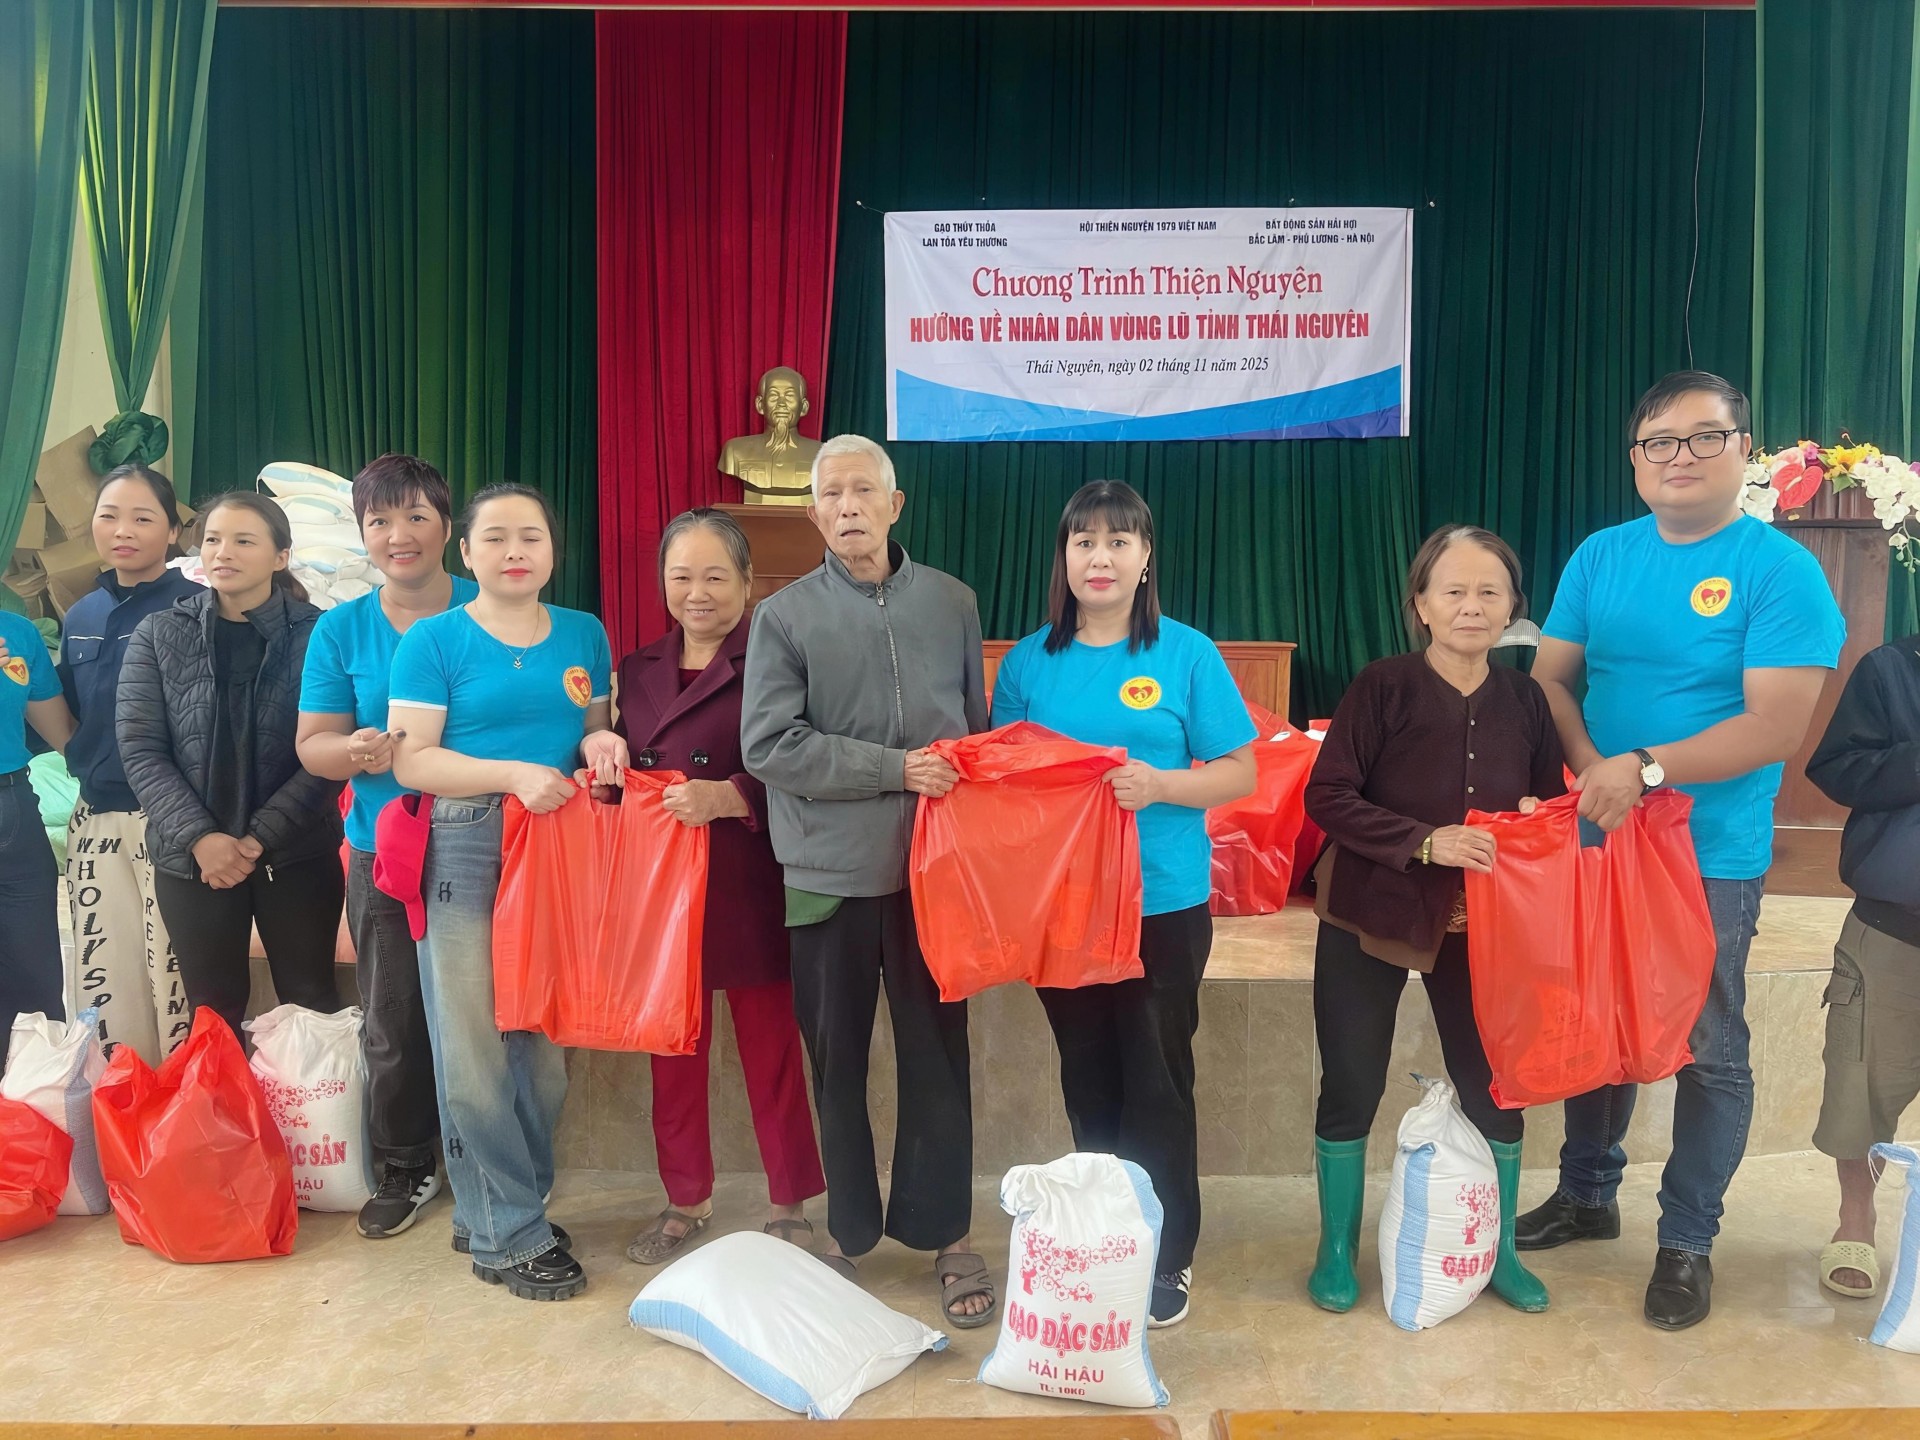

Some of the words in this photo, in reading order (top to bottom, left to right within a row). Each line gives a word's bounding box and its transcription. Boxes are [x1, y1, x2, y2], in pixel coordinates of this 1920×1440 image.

[934, 223, 951, 234] GẠO
[1080, 221, 1094, 233] HỘI
[1096, 221, 1119, 232] THIỆN
[1122, 220, 1154, 232] NGUYỆN
[1157, 222, 1176, 231] 1979
[1179, 220, 1195, 232] VIỆT
[1198, 221, 1217, 231] NAM
[1265, 218, 1281, 230] BẤT
[1283, 219, 1306, 231] ĐỘNG
[1308, 217, 1325, 229] SẢN
[922, 238, 939, 247] LAN
[958, 236, 973, 247] YÊU
[975, 237, 1008, 247] THƯƠNG
[1311, 234, 1339, 244] LƯƠNG
[1347, 233, 1358, 243] HÀ
[1360, 232, 1375, 244] NỘI
[972, 267, 1073, 303] Chương
[1078, 267, 1146, 296] Trình
[1150, 265, 1222, 301] Thiện
[1226, 265, 1323, 300] Nguyện
[910, 312, 974, 342] HƯỚNG
[979, 309, 1002, 342] VỀ
[1008, 312, 1059, 342] NHÂN
[1066, 312, 1103, 342] DÂN
[1110, 312, 1161, 341] VÙNG
[1168, 311, 1190, 340] LŨ
[1196, 309, 1239, 340] TỈNH
[1246, 310, 1289, 339] THÁI
[1295, 309, 1369, 339] NGUYÊN
[1026, 360, 1054, 374] Thái
[1056, 359, 1104, 376] Nguyên,
[1108, 359, 1136, 375] ngày
[1139, 359, 1153, 372] 02
[1157, 358, 1191, 375] tháng
[1193, 358, 1207, 372] 11
[1211, 359, 1237, 372] năm
[1241, 357, 1269, 371] 2025
[309, 1134, 347, 1167] SẢN
[1441, 1253, 1480, 1285] GẠO
[1008, 1300, 1038, 1343] GẠO
[1040, 1312, 1088, 1358] ĐẶC
[1089, 1310, 1132, 1353] SẢN
[1028, 1359, 1058, 1379] HẢI
[1064, 1366, 1104, 1385] HẬU
